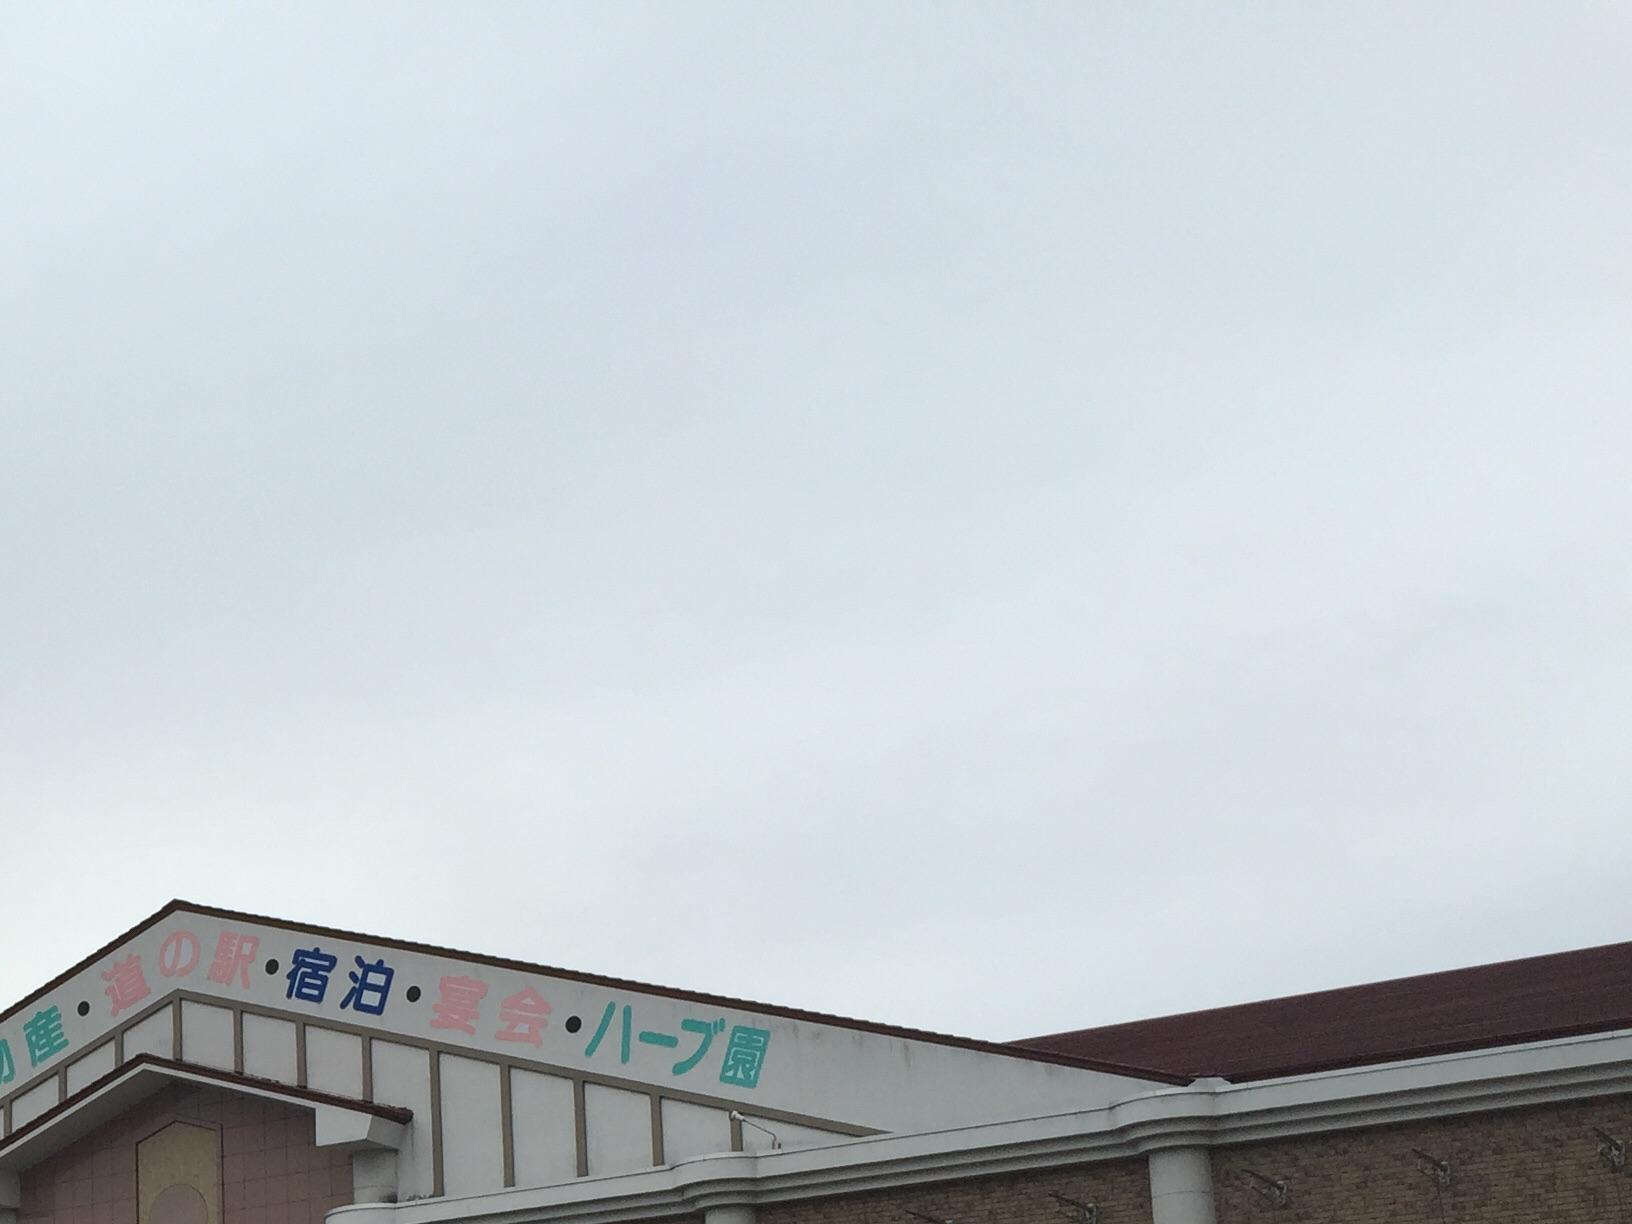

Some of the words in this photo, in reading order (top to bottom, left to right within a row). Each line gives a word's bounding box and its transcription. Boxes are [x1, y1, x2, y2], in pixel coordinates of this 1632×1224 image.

[101, 930, 261, 1017] 道の駅
[285, 947, 395, 1016] 宿泊
[430, 975, 552, 1048] 宴会
[584, 1002, 770, 1089] ハーブ園
